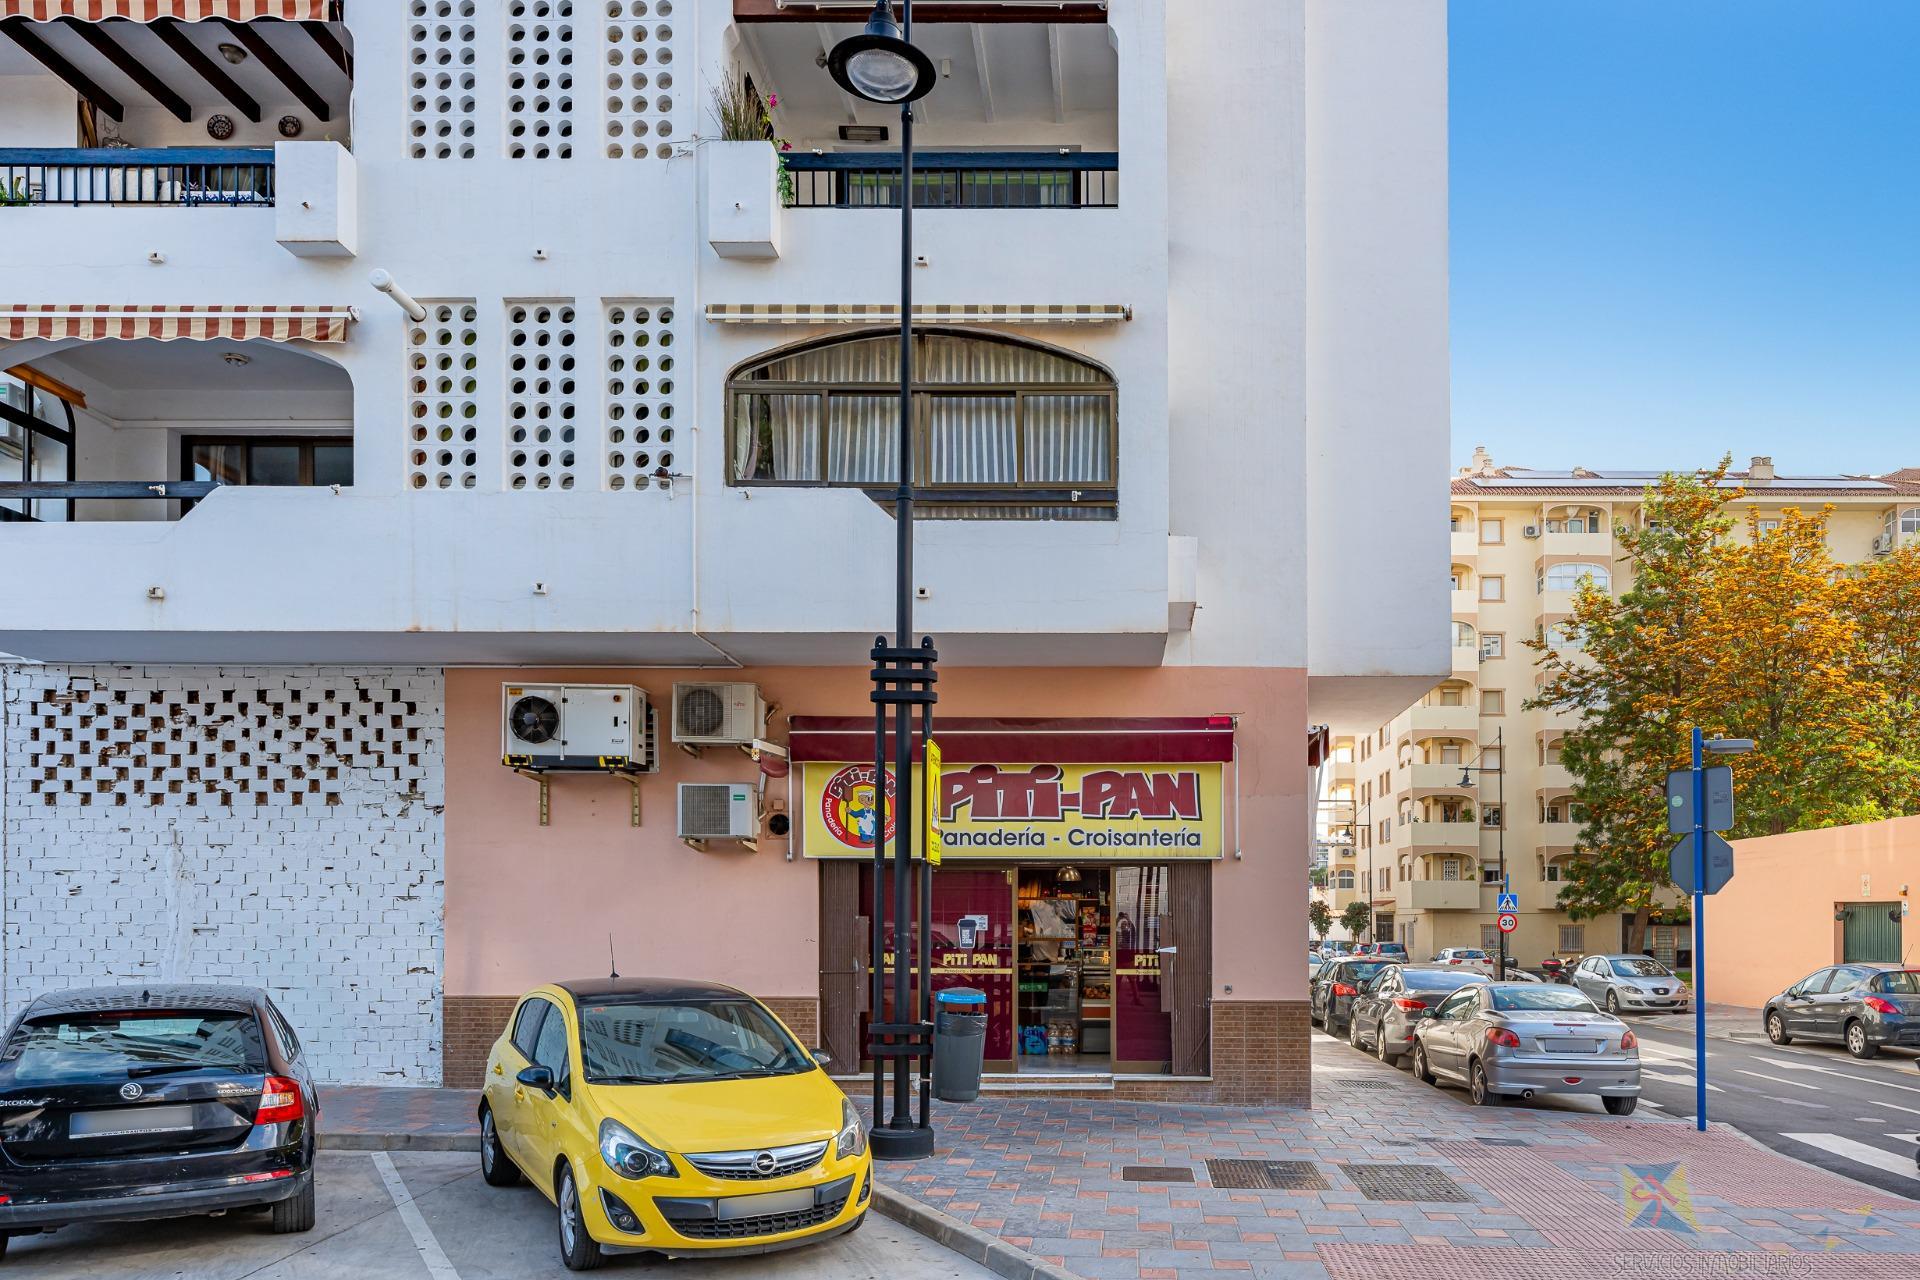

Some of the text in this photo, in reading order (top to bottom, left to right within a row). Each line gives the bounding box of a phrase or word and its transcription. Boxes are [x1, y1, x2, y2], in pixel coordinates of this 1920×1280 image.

[940, 826, 1045, 846] anadería
[1068, 827, 1201, 846] Croisantería
[973, 953, 998, 966] PAN
